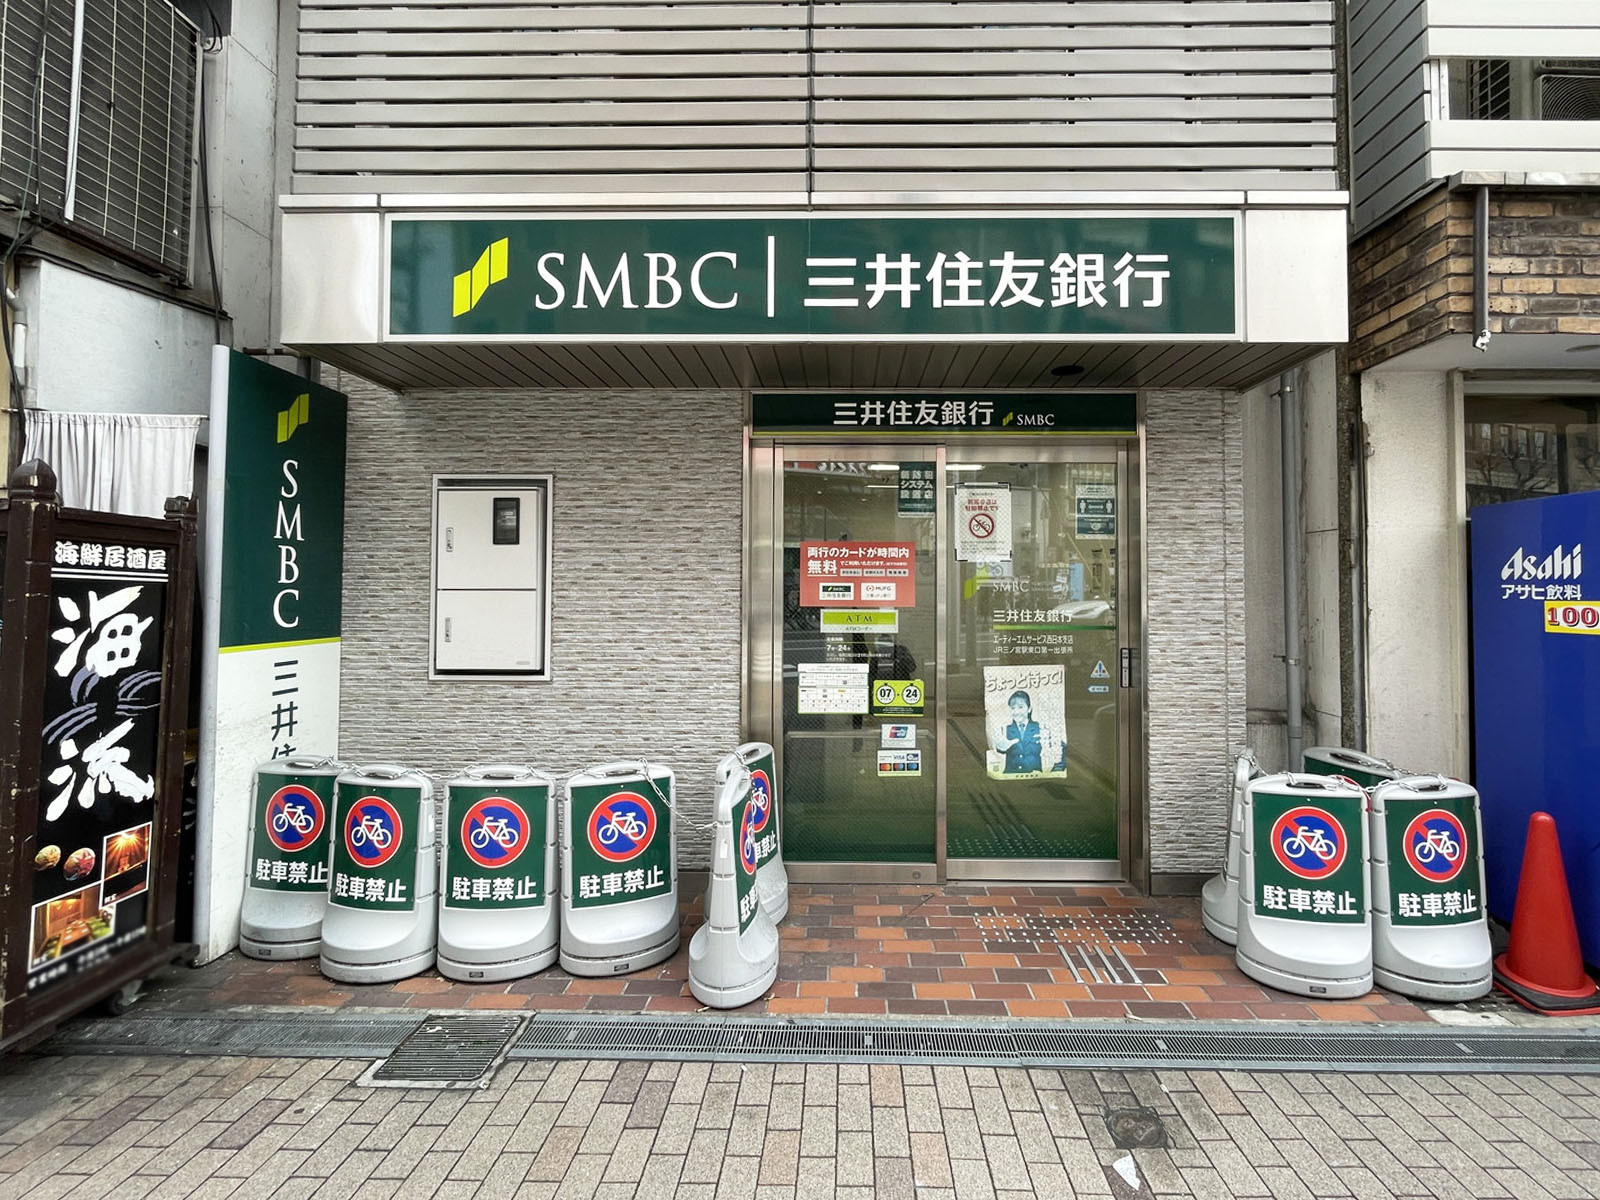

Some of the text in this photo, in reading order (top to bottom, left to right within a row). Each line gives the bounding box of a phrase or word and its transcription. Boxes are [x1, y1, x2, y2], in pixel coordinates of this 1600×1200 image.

[535, 251, 738, 309] SMBC
[804, 251, 1170, 309] 三井住友銀行
[833, 400, 994, 426] 三井住友銀行
[1016, 413, 1055, 426] SMBC
[900, 480, 934, 489] システム
[55, 541, 167, 571] 海鮮居酒屋
[273, 459, 305, 628] SMBC
[807, 546, 910, 558] 両行のカードが時間内
[807, 560, 838, 575] 無料
[1501, 543, 1582, 581] Asahi
[993, 581, 1030, 593] SMBC
[1501, 584, 1582, 601] アサヒ飲料
[993, 609, 1073, 623] 三井住友銀行
[1548, 606, 1600, 628] 100
[880, 689, 891, 698] 07
[905, 689, 918, 698] 24
[255, 858, 329, 884] 駐車禁止
[579, 865, 665, 900] 駐車禁止
[335, 872, 406, 902] 駐車禁止
[452, 875, 537, 901] 駐車禁止
[1263, 885, 1358, 915] 駐車禁止
[1399, 889, 1477, 917] 駐車禁止
